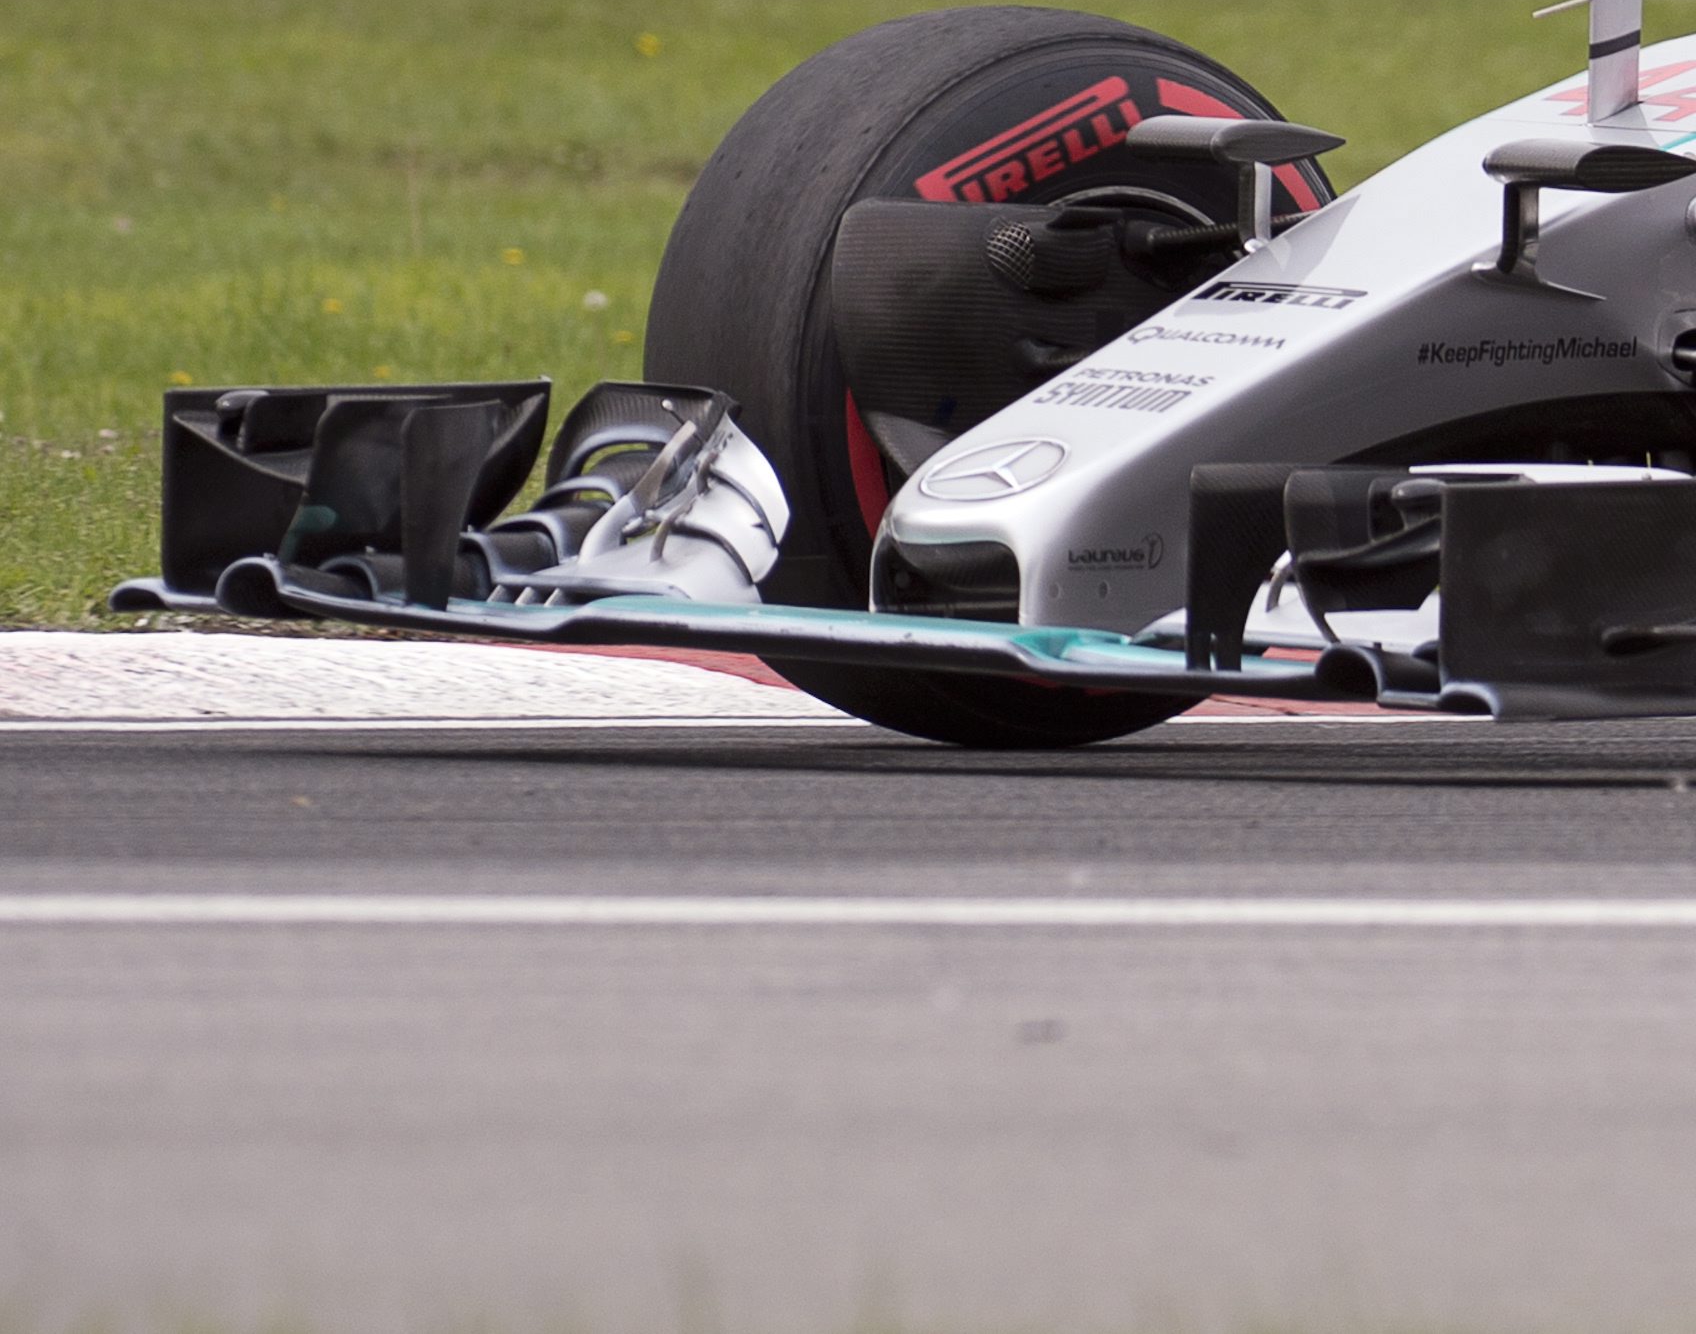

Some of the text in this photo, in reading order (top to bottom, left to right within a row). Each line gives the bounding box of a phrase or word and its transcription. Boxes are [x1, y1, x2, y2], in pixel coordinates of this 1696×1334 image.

[913, 75, 1143, 203] PIRELLI
[1191, 281, 1369, 310] PIRELLI
[1417, 335, 1639, 367] #KeepFightingMichael
[1073, 367, 1216, 388] PETRONAS
[1033, 382, 1193, 414] SYNTIUM
